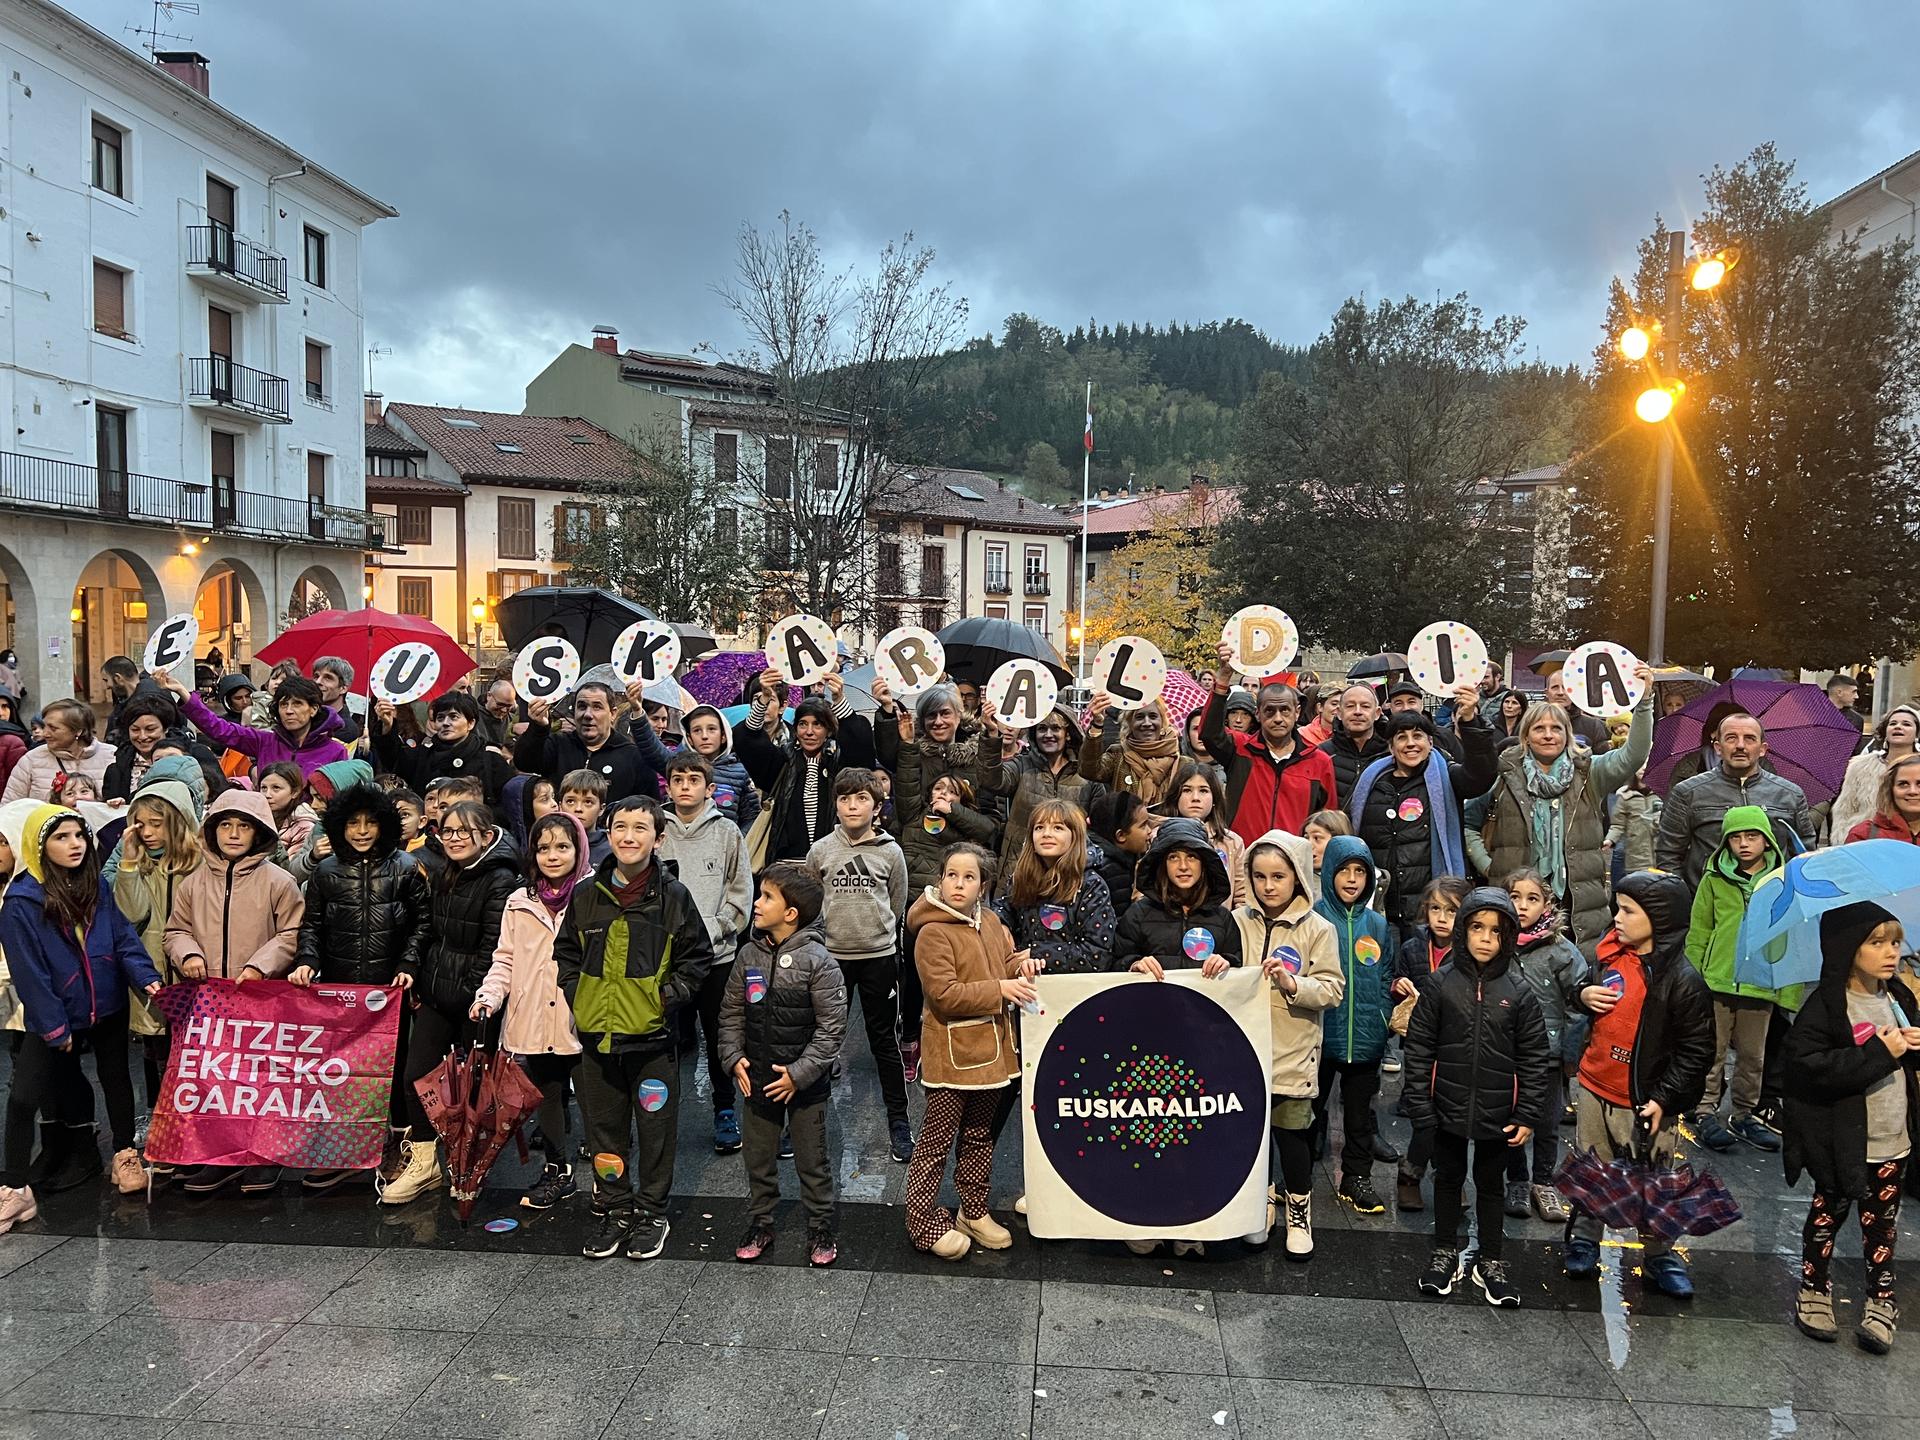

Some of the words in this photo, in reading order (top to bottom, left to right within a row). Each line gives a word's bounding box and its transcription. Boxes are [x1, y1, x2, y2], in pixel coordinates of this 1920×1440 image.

[155, 620, 186, 667] E
[623, 630, 671, 681] K
[785, 626, 828, 681] A
[889, 638, 927, 687] R
[1240, 617, 1288, 667] D
[1435, 633, 1456, 685] I
[384, 650, 430, 695] U
[528, 646, 563, 697] S
[1000, 670, 1036, 720] A
[1106, 643, 1144, 701] L
[1586, 652, 1629, 707] A
[832, 875, 877, 887] adidas
[337, 991, 356, 1001] 365
[184, 1016, 324, 1054] HITZEZ
[177, 1049, 350, 1086] EKITEKO
[173, 1082, 332, 1120] GARAIA
[1058, 1092, 1244, 1118] EUSKARALDIA
